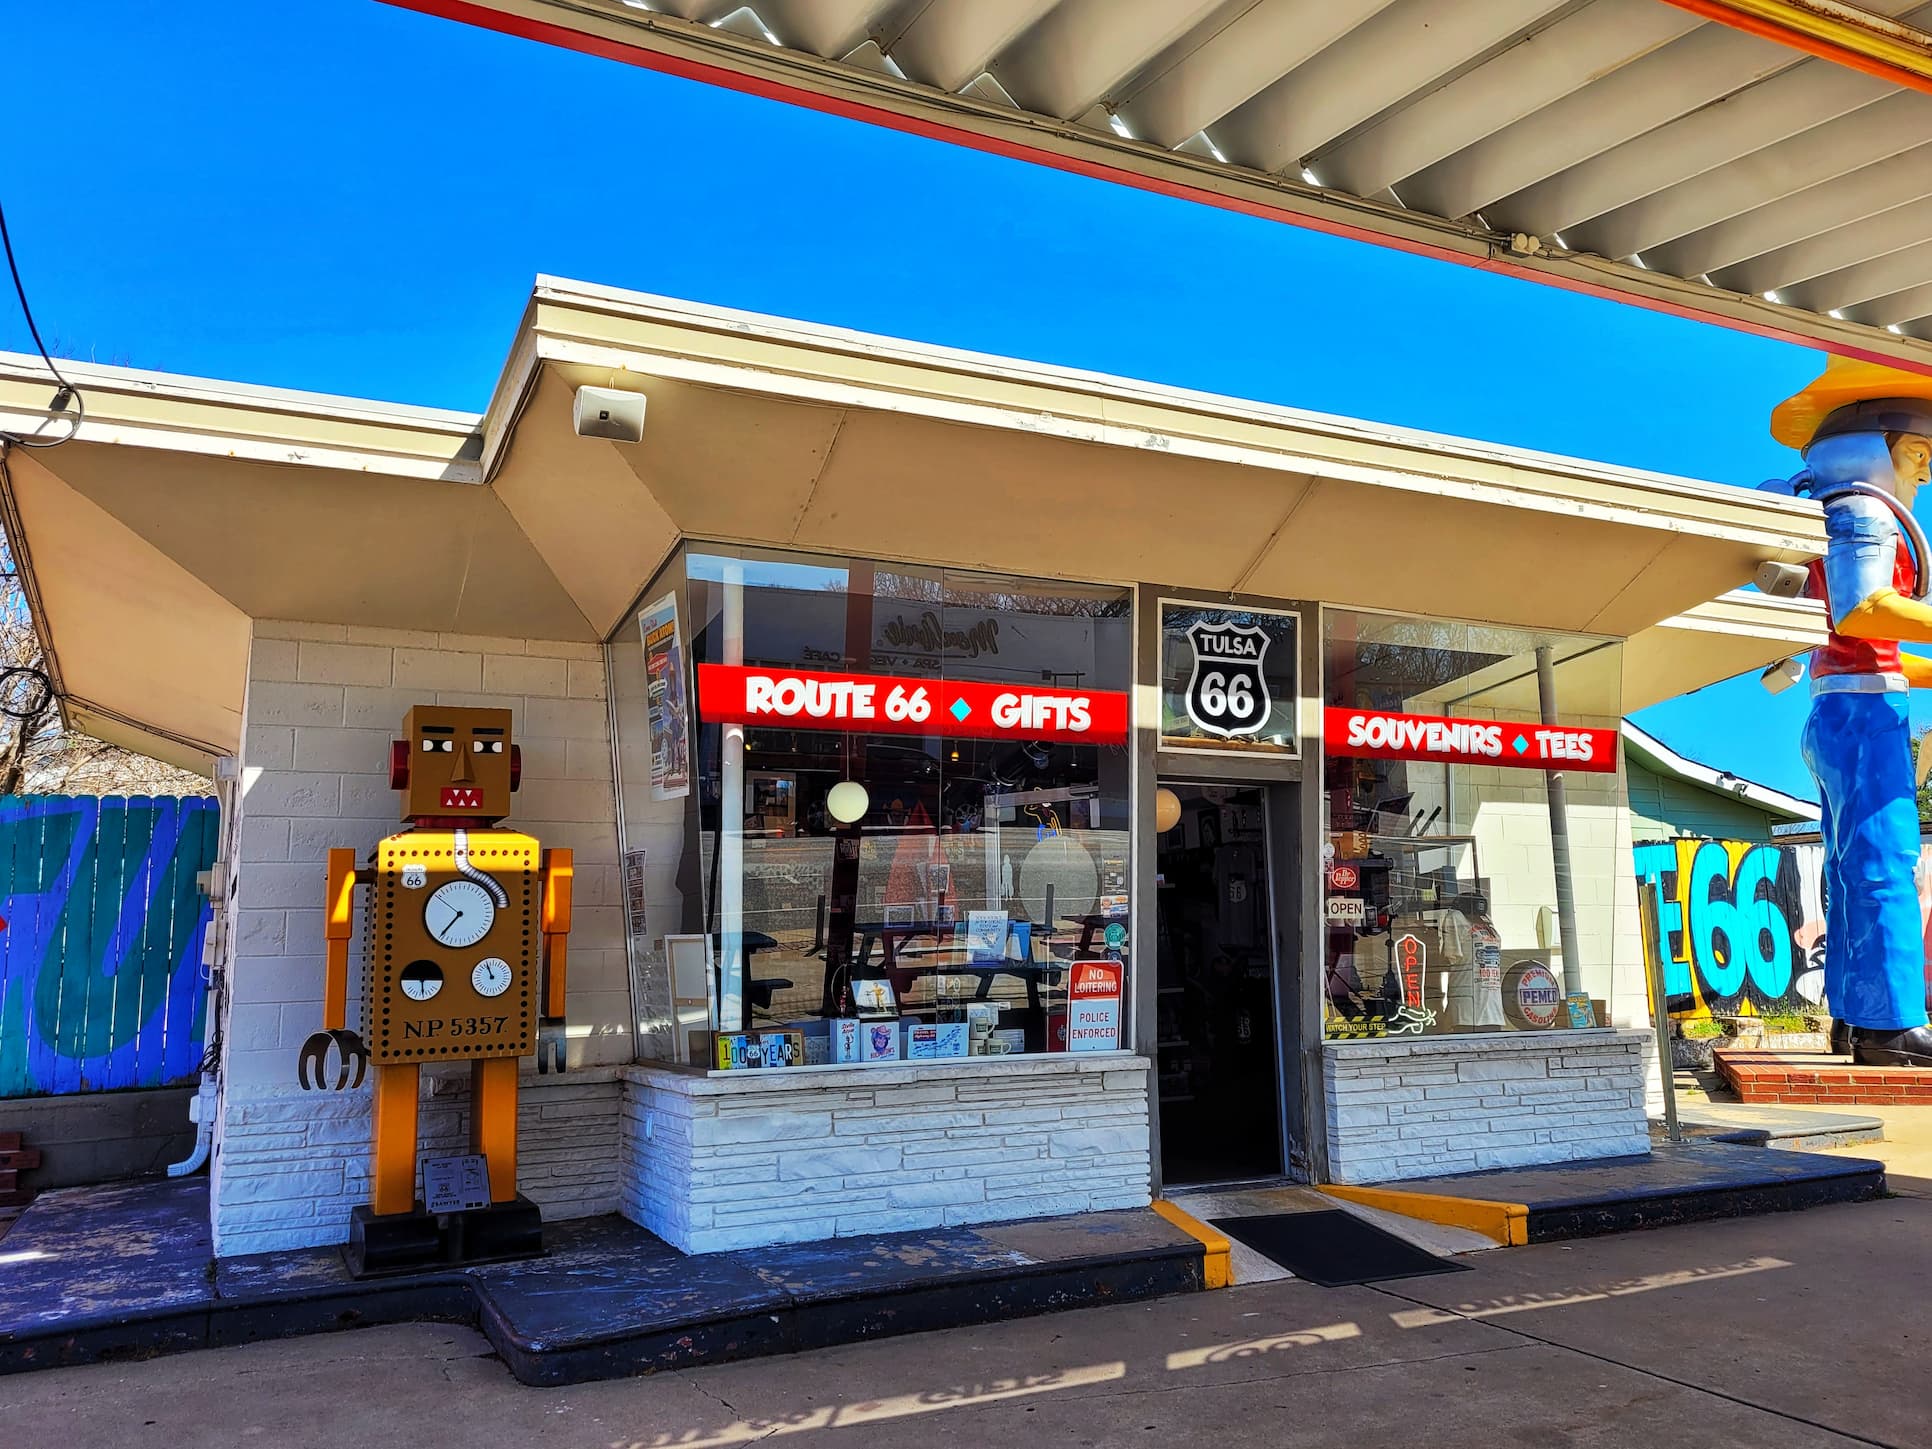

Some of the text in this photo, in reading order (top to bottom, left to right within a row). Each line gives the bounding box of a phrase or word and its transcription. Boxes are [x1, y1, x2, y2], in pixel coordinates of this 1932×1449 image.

[1200, 634, 1257, 656] TULSA
[1201, 671, 1254, 718] 66
[745, 676, 1092, 732] ROUTE 66 GIFTS
[1347, 715, 1593, 761] SOUVENIRS TEES
[406, 876, 421, 886] 66
[1331, 903, 1362, 915] OPEN
[1691, 843, 1792, 999] 66
[1089, 969, 1103, 980] NO
[1404, 938, 1420, 1008] OPEN
[1521, 969, 1556, 987] PREMIUM
[1074, 982, 1117, 993] LOITERING
[1523, 990, 1557, 1003] PEMCO
[1079, 1012, 1110, 1023] POLICE
[1523, 1006, 1558, 1024] GASOLINE
[1072, 1027, 1116, 1039] ENFORCED
[1326, 1022, 1386, 1033] WATCH YOUR STEP
[723, 1044, 746, 1064] 100
[762, 1043, 800, 1064] YEARS
